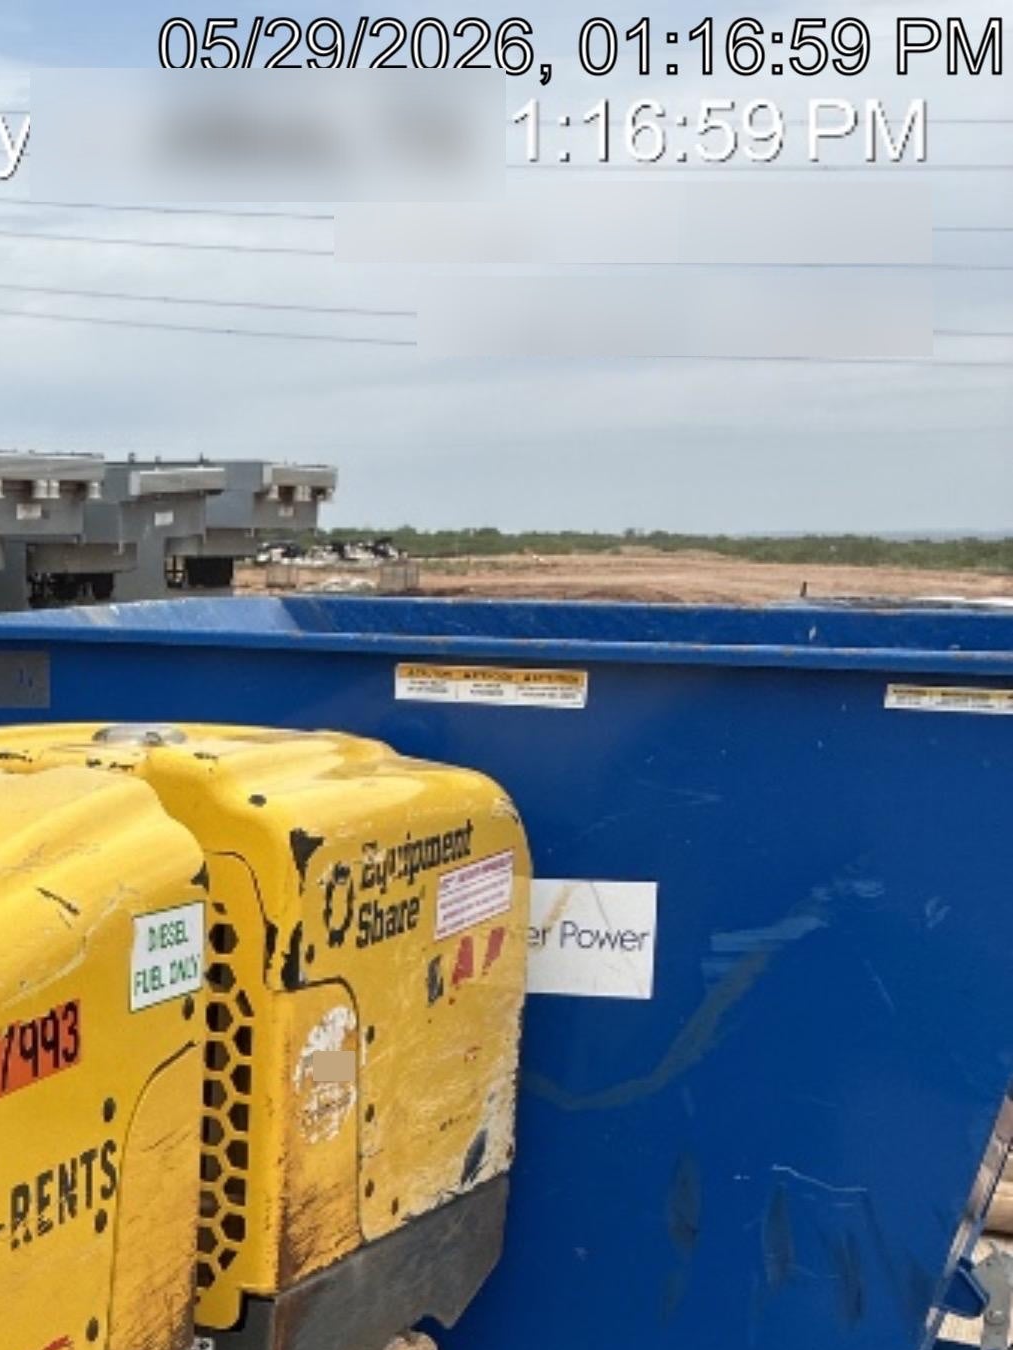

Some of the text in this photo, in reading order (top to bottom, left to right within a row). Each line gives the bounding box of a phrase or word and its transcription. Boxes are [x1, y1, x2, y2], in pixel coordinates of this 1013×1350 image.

[148, 920, 189, 953] DIESEL
[355, 896, 420, 949] Share
[560, 920, 649, 952] Power
[134, 965, 166, 996] FUEL
